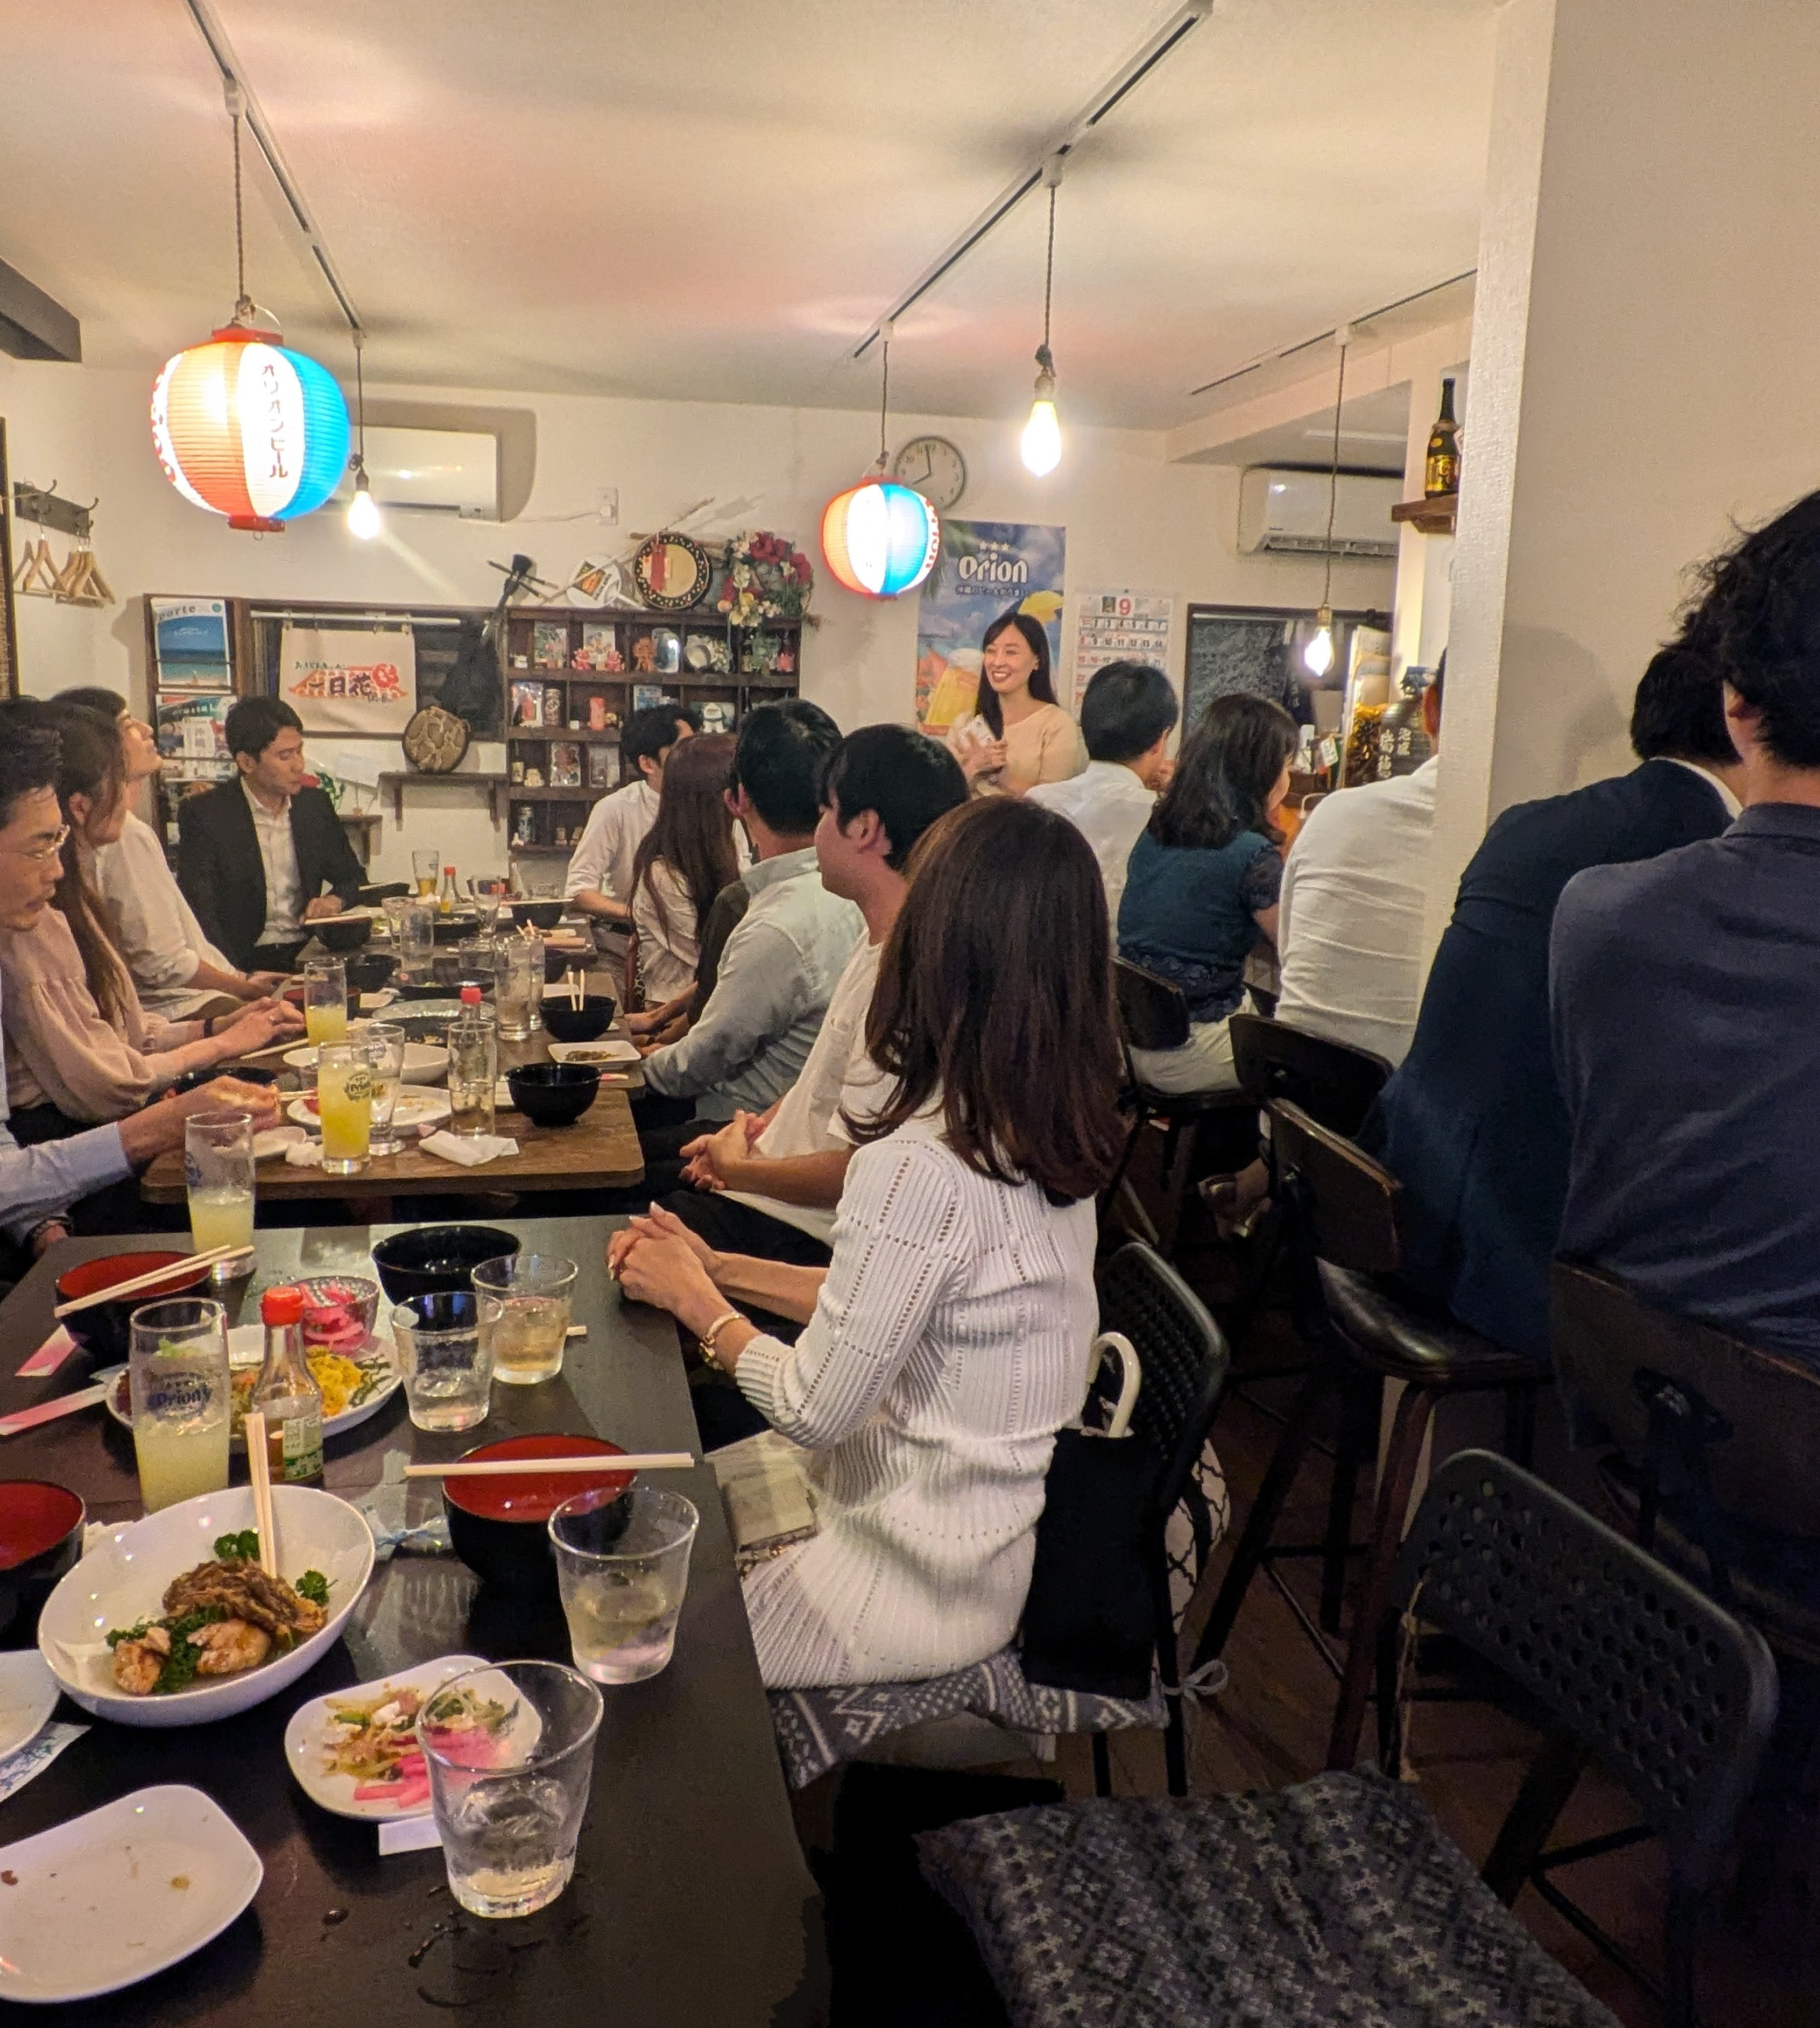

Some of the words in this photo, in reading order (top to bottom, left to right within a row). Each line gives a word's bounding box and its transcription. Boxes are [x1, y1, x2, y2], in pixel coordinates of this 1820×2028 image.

[958, 552, 1028, 583] Orion
[1119, 598, 1131, 615] 9
[308, 672, 372, 697] 一日花
